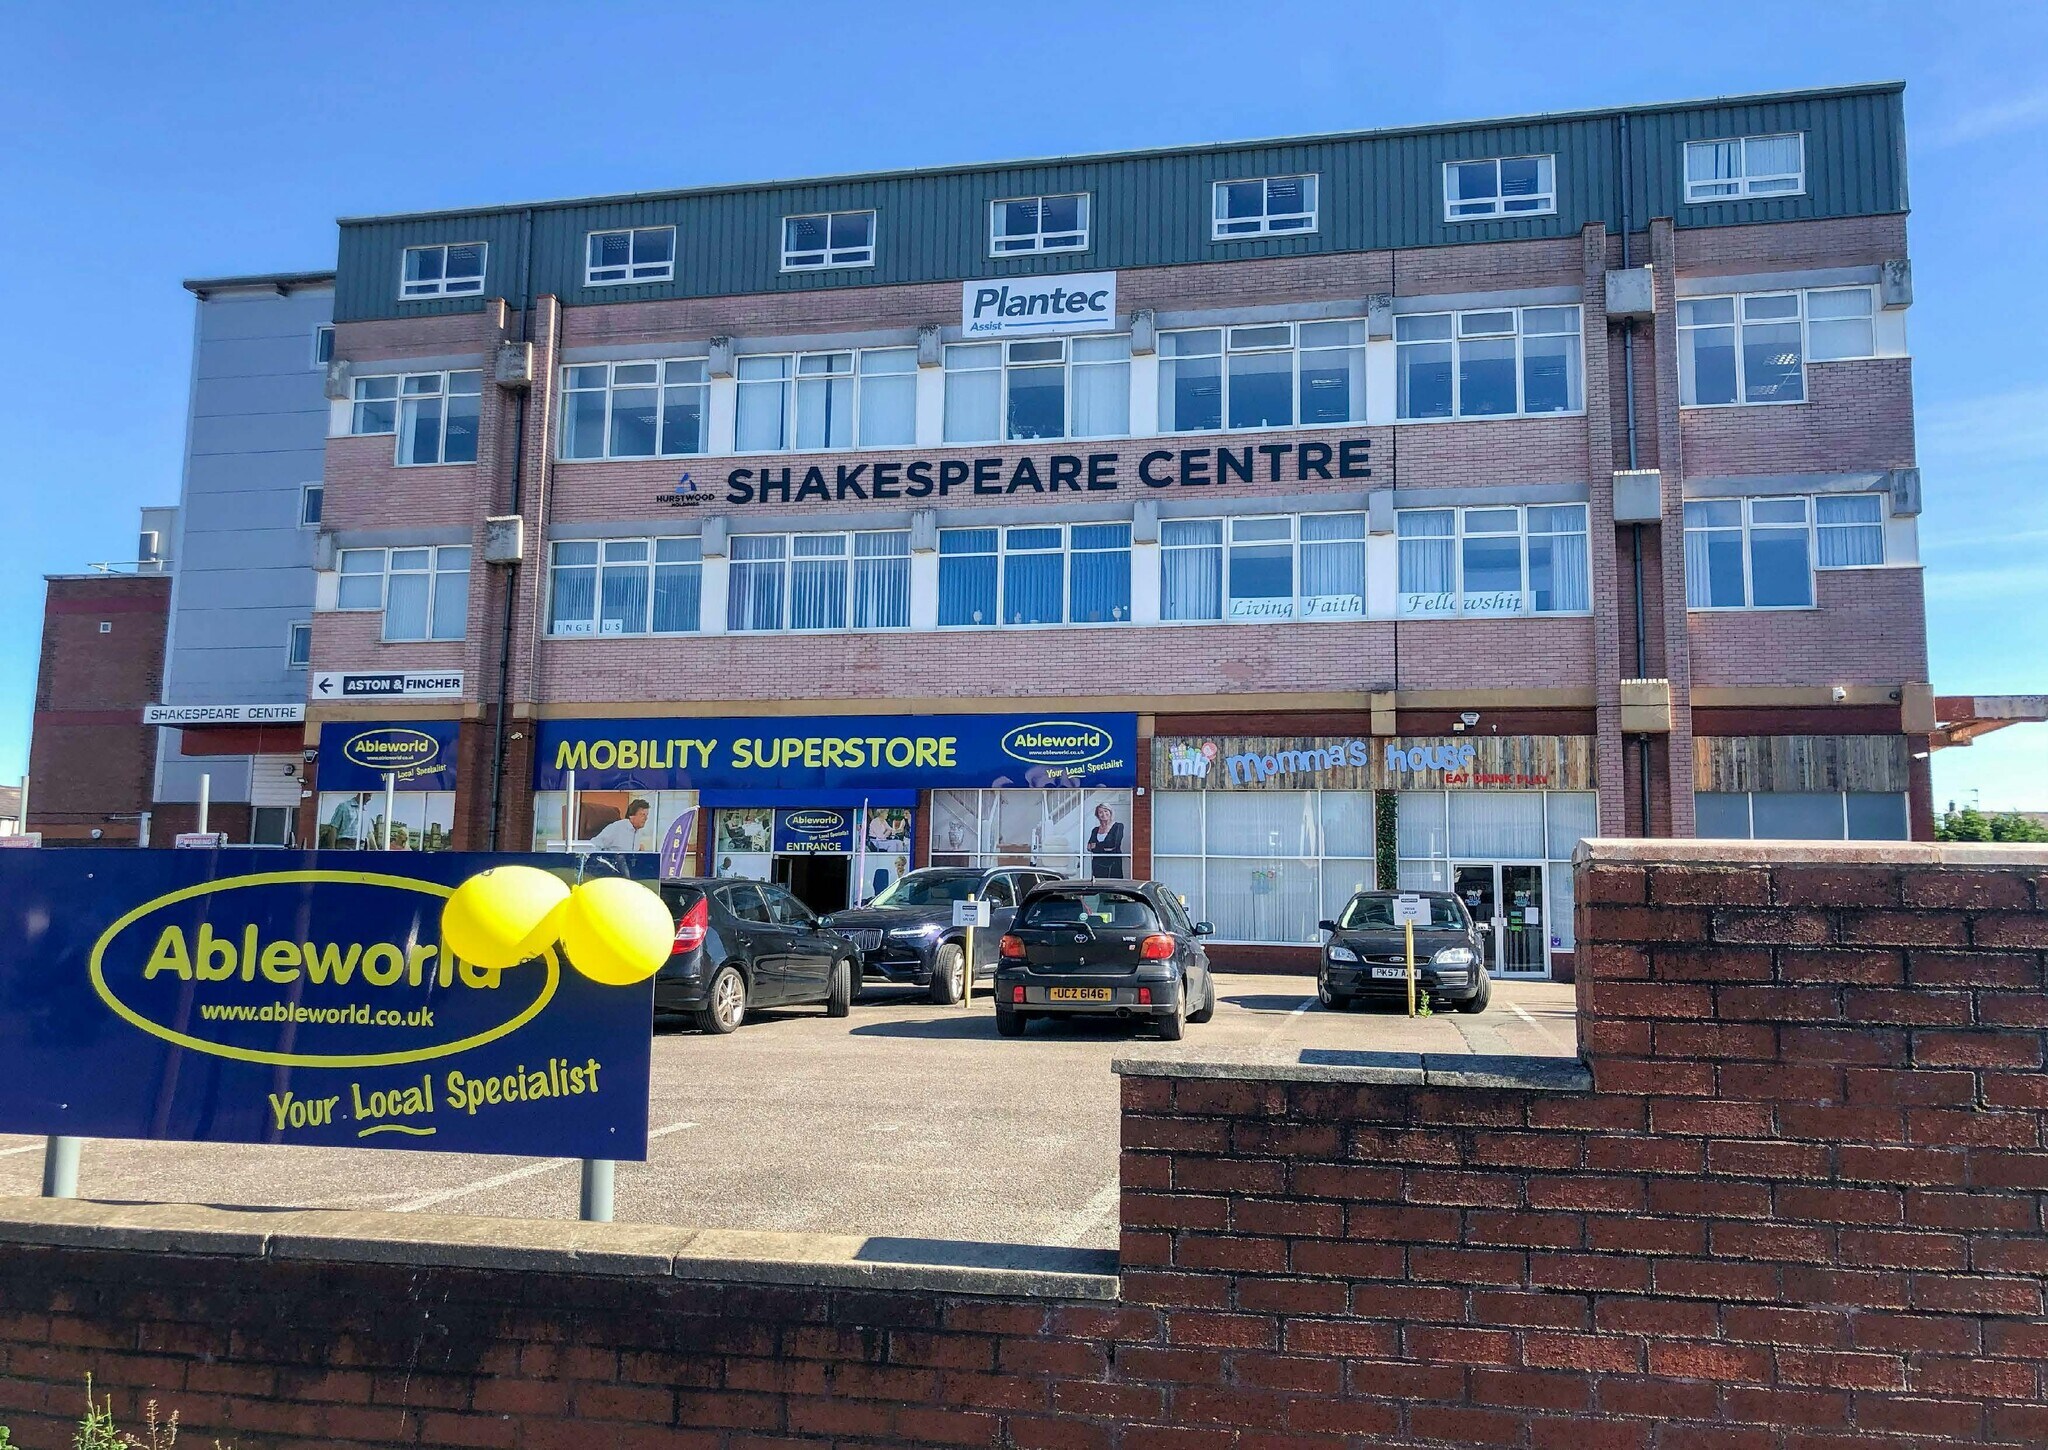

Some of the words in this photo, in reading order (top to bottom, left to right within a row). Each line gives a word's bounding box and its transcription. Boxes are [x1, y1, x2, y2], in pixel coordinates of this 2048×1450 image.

[973, 285, 1109, 319] Plantec
[970, 321, 1003, 332] Assist
[726, 453, 1118, 505] SHAKESPEARE
[1138, 439, 1372, 488] CENTRE
[656, 493, 715, 503] HURSTWOOD
[1230, 599, 1294, 618] Living
[1304, 594, 1360, 616] Faith
[347, 679, 391, 692] ASTON
[393, 679, 403, 691] &
[406, 677, 460, 690] FINCHER
[150, 708, 240, 721] SHAKESPEARE
[248, 706, 297, 719] CENTRE
[355, 739, 429, 753] Ableworld
[1014, 732, 1100, 748] Ableworld
[554, 739, 718, 770] MOBILITY
[731, 736, 958, 768] SUPERSTORE
[1386, 744, 1477, 773] house
[1046, 768, 1064, 779] Your
[1065, 764, 1085, 775] Local
[1087, 759, 1124, 773] Specialist
[1445, 773, 1470, 784] EAT
[792, 815, 838, 824] Ableworld
[786, 842, 842, 851] ENTRANCE
[1057, 987, 1078, 999] UCZ
[1080, 988, 1104, 999] 6146
[201, 1001, 434, 1027] www.ableworld.co.uk
[269, 1091, 340, 1130] Your
[352, 1074, 434, 1121] Local
[447, 1058, 601, 1115] Specialist
